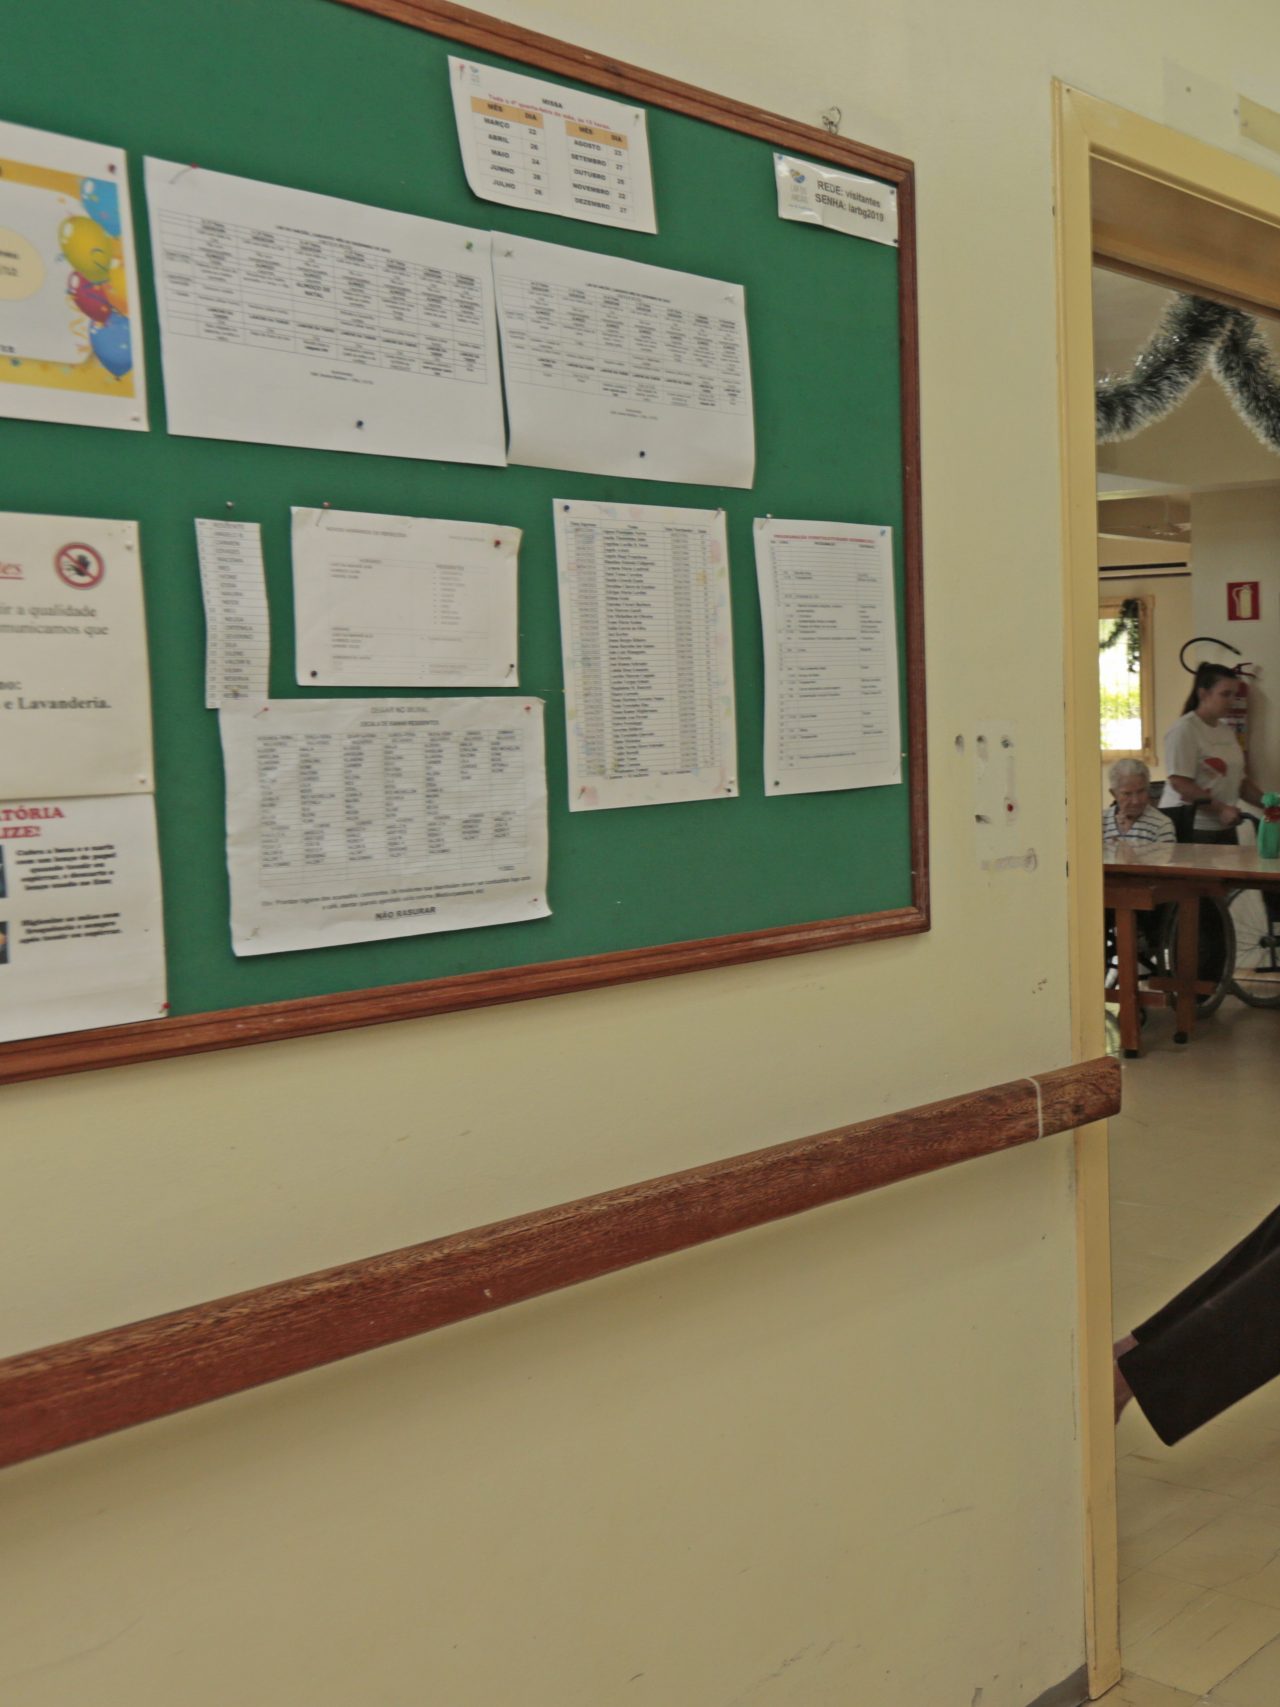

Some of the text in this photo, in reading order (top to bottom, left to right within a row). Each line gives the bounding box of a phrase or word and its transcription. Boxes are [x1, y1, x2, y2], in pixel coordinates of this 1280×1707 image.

[524, 111, 537, 121] DIA
[483, 117, 510, 129] MARÇO
[488, 133, 510, 144] ABRIL
[573, 139, 602, 151] AGOSTO
[490, 149, 510, 159] MAIO
[571, 153, 607, 167] SETEMBRO
[490, 164, 515, 175] JUNHO
[573, 168, 607, 181] OUTUBRO
[492, 179, 517, 190] JULHO
[572, 182, 610, 196] NOVEMBRO
[817, 180, 881, 208] REDE: visitantes
[573, 197, 611, 210] DEZEMBRO
[815, 193, 846, 210] SENHA:
[28, 604, 97, 618] qualidade
[18, 696, 112, 710] Lavanderia.
[0, 805, 64, 821] TÓRIA
